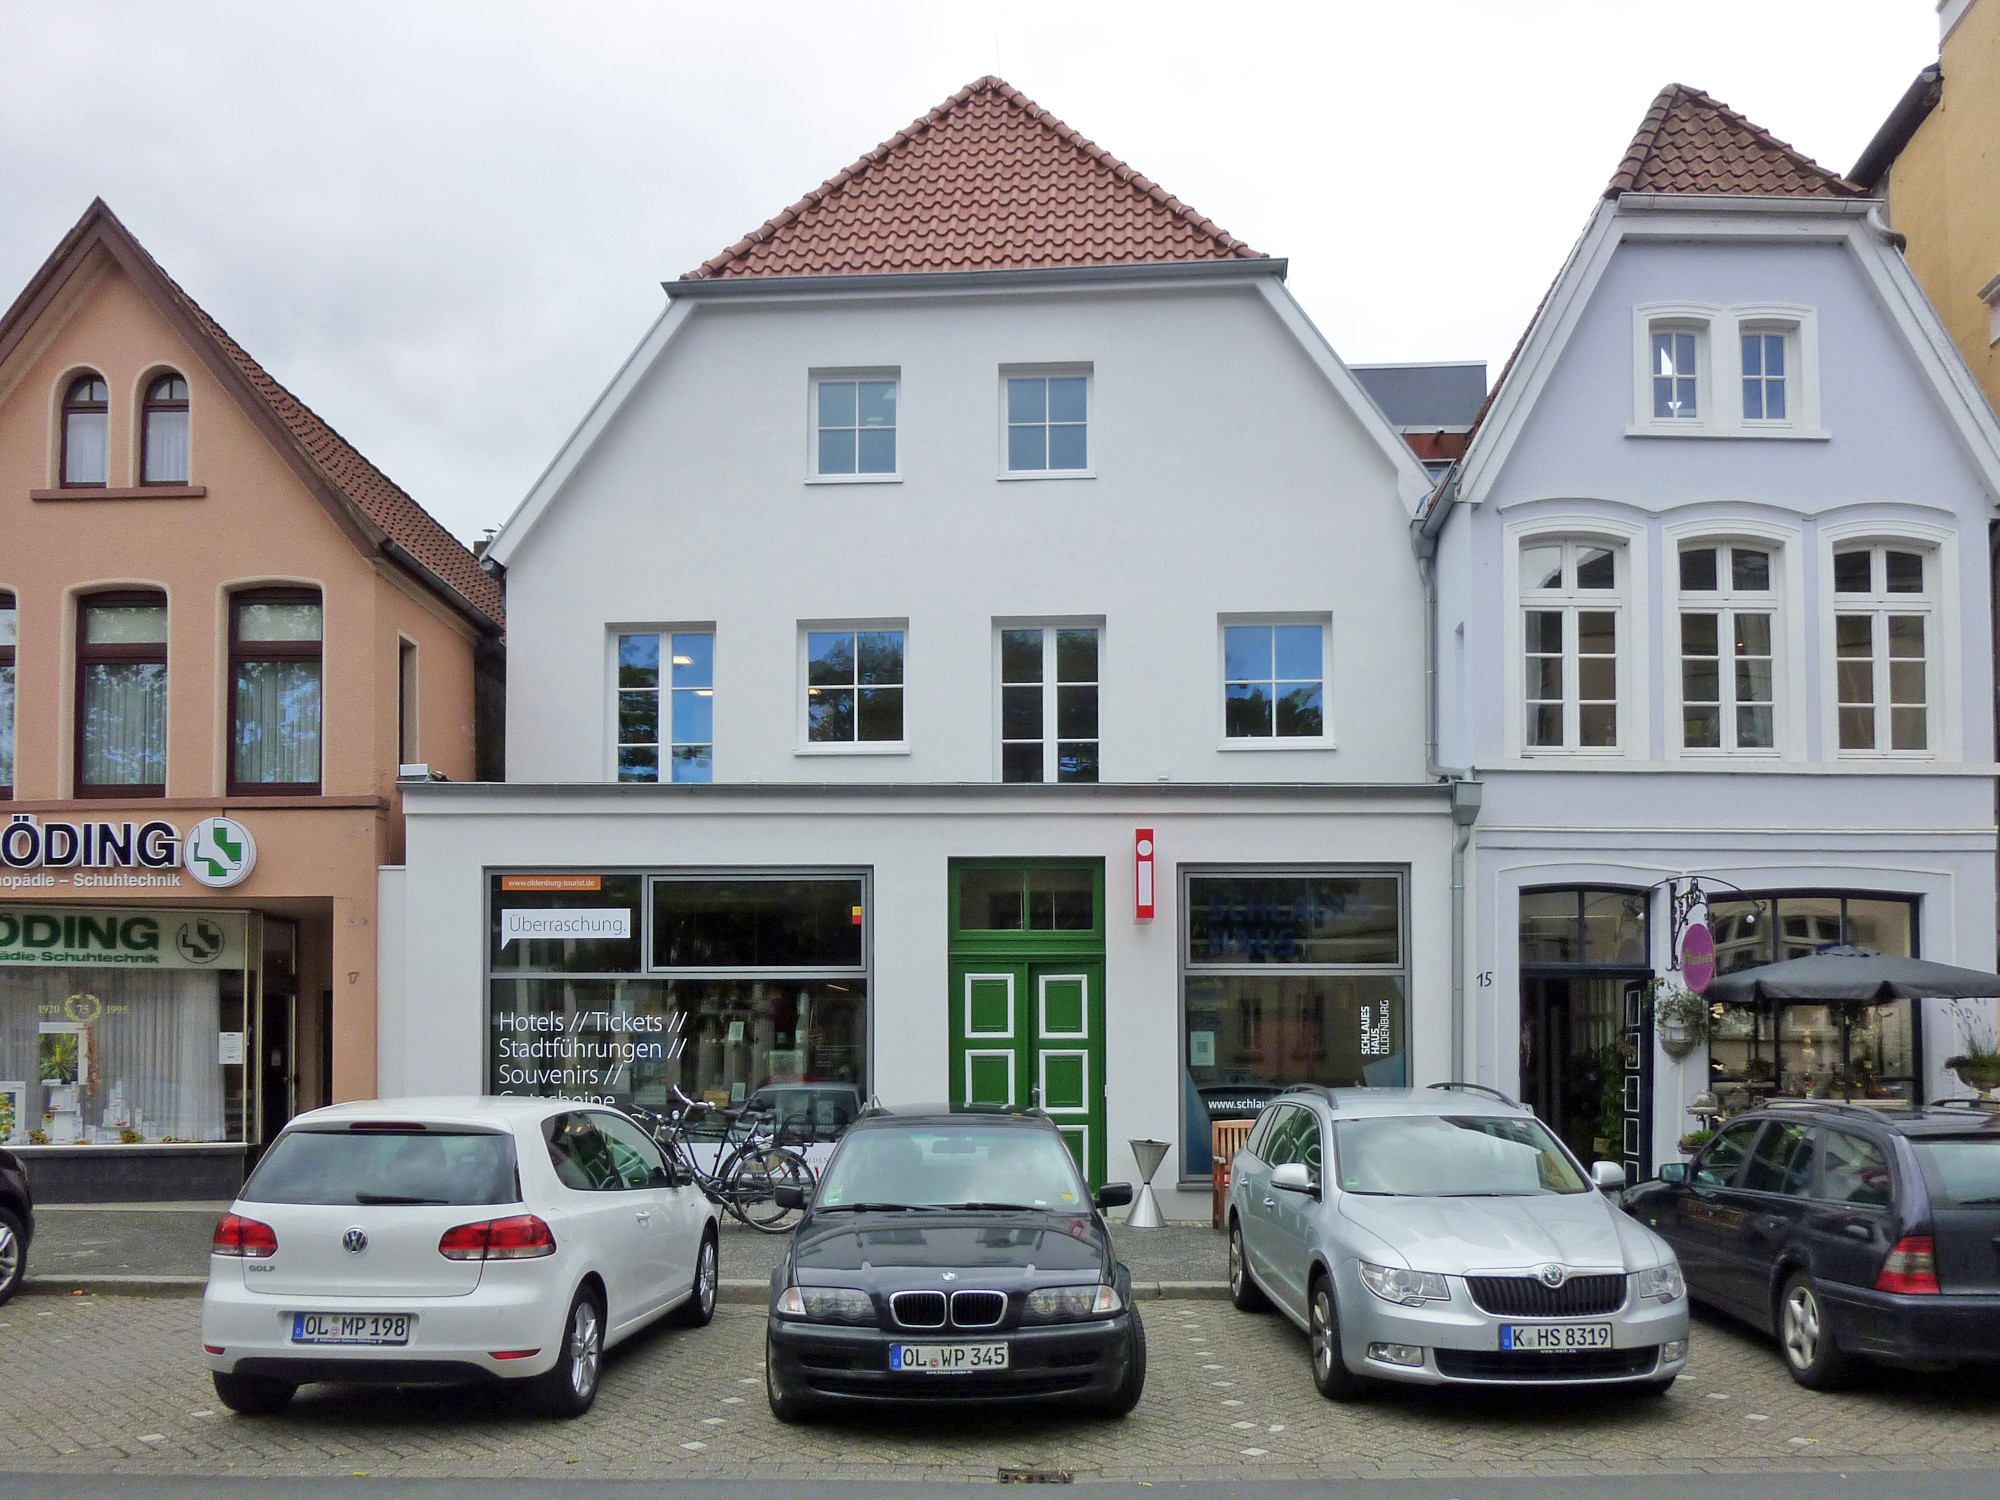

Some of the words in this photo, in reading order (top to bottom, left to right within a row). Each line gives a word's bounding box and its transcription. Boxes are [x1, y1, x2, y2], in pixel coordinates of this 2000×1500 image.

[74, 872, 181, 887] Schuhtechnik
[508, 879, 595, 888] www.oldenburg-tourist.de
[509, 913, 627, 936] Überraschung.
[347, 971, 361, 984] 17
[1476, 971, 1493, 987] 15
[37, 1004, 60, 1014] 1920
[77, 1004, 90, 1014] 75
[106, 1004, 129, 1015] 1995
[500, 1011, 564, 1032] Hotels
[592, 1011, 663, 1032] Tickets
[1360, 1005, 1370, 1055] SCHLAUES
[1380, 999, 1390, 1055] OLDENBURG
[499, 1037, 662, 1063] Stadtführungen
[499, 1064, 599, 1084] Souvenirs
[248, 1264, 276, 1272] GOLF
[305, 1316, 329, 1335] OL
[341, 1316, 366, 1336] MP
[369, 1317, 406, 1337] 198
[1513, 1328, 1525, 1347] K
[1537, 1328, 1561, 1347] HS
[1565, 1327, 1608, 1346] 8319
[903, 1348, 927, 1367] OL
[941, 1348, 965, 1367] WP
[970, 1346, 1005, 1366] 345
